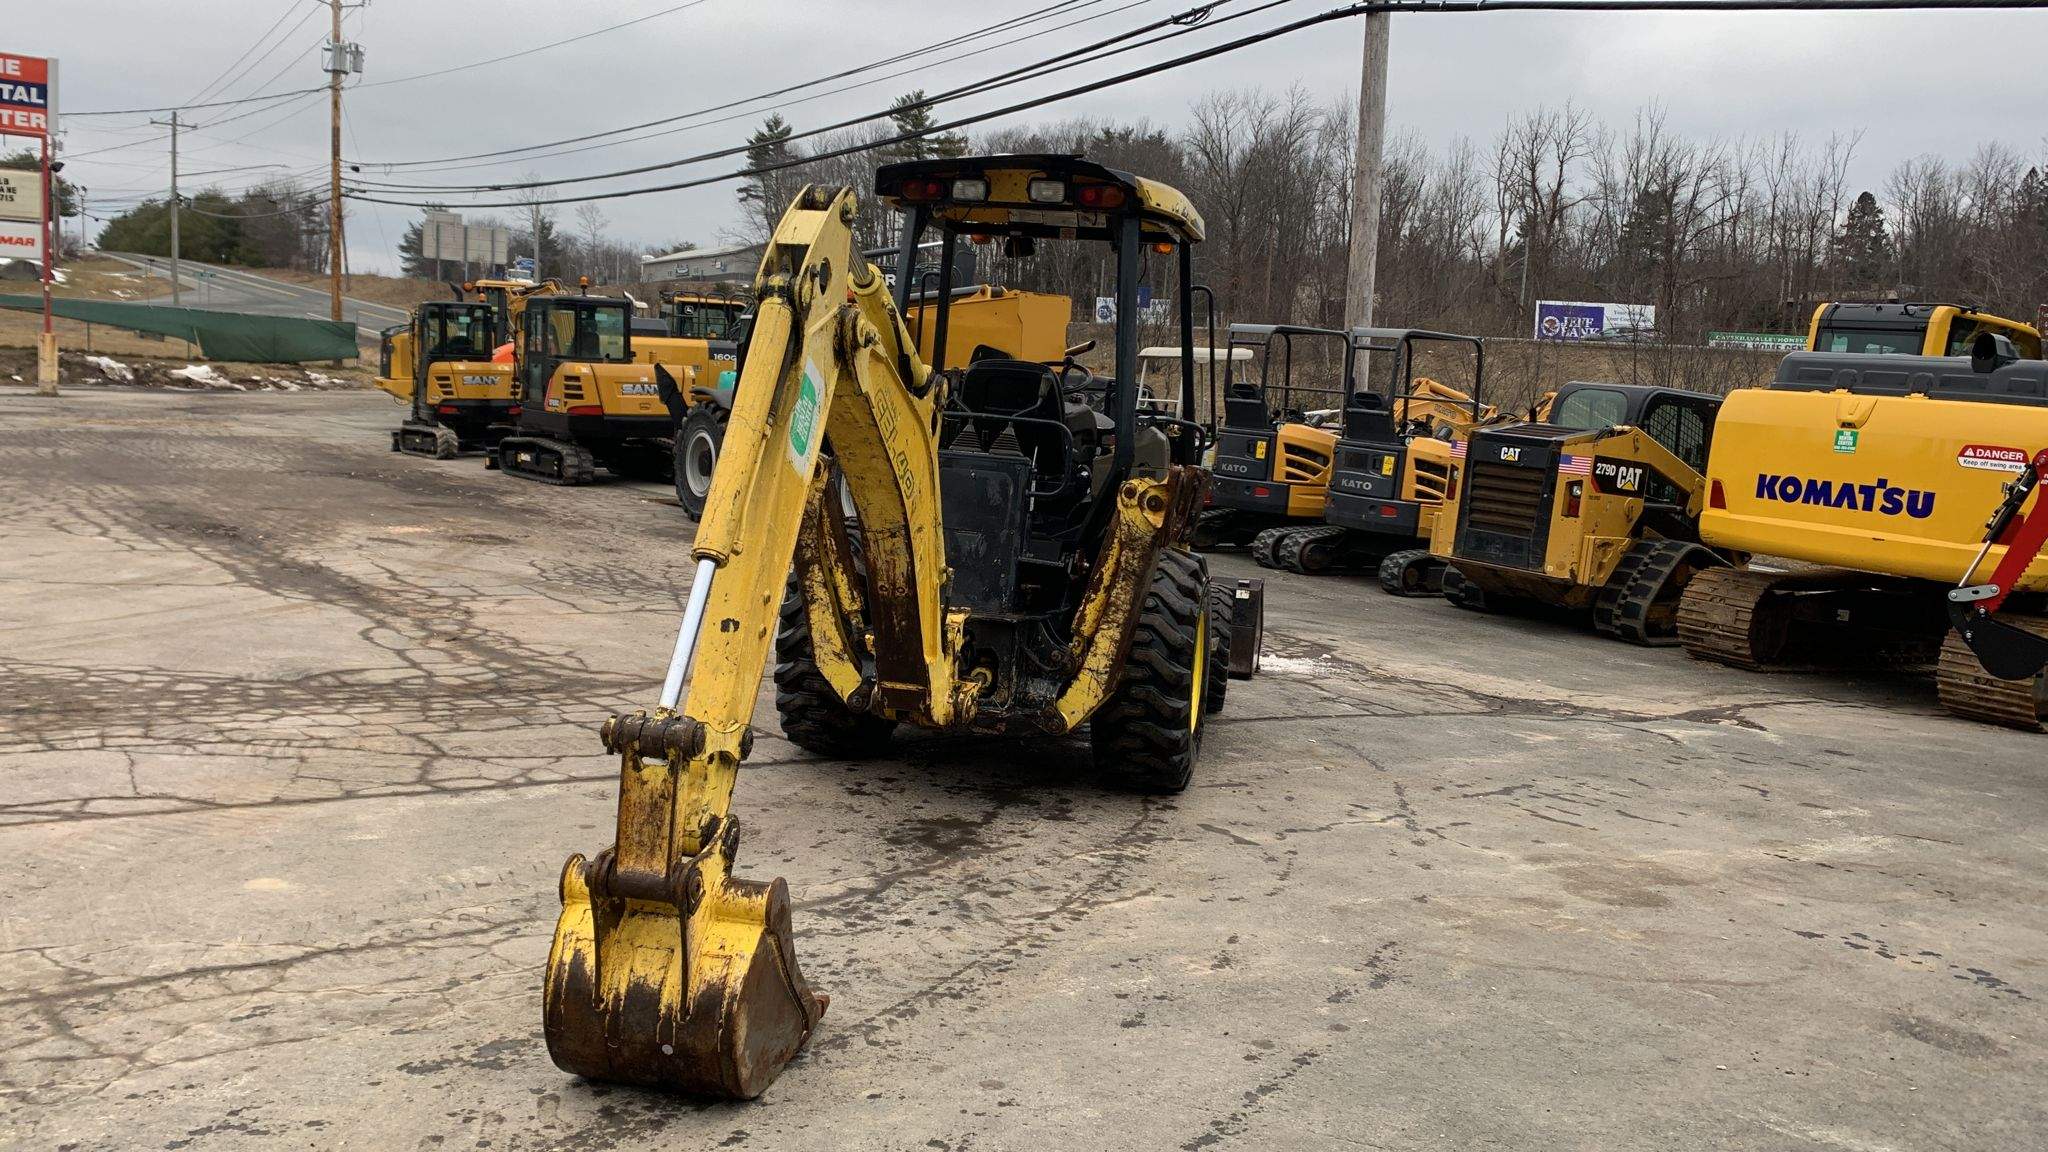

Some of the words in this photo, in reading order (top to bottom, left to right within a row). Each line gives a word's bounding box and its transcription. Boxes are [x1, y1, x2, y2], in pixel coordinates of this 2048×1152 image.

[0, 58, 21, 75] E
[463, 375, 500, 385] SANY
[1500, 446, 1521, 461] CAT
[1976, 449, 2024, 461] DANGER
[1221, 463, 1248, 473] KATO
[1963, 459, 1978, 467] Keep
[1595, 463, 1616, 477] 279D
[1617, 466, 1643, 491] CAT
[1341, 478, 1372, 490] KATO
[1755, 473, 1936, 518] KOMATSU
